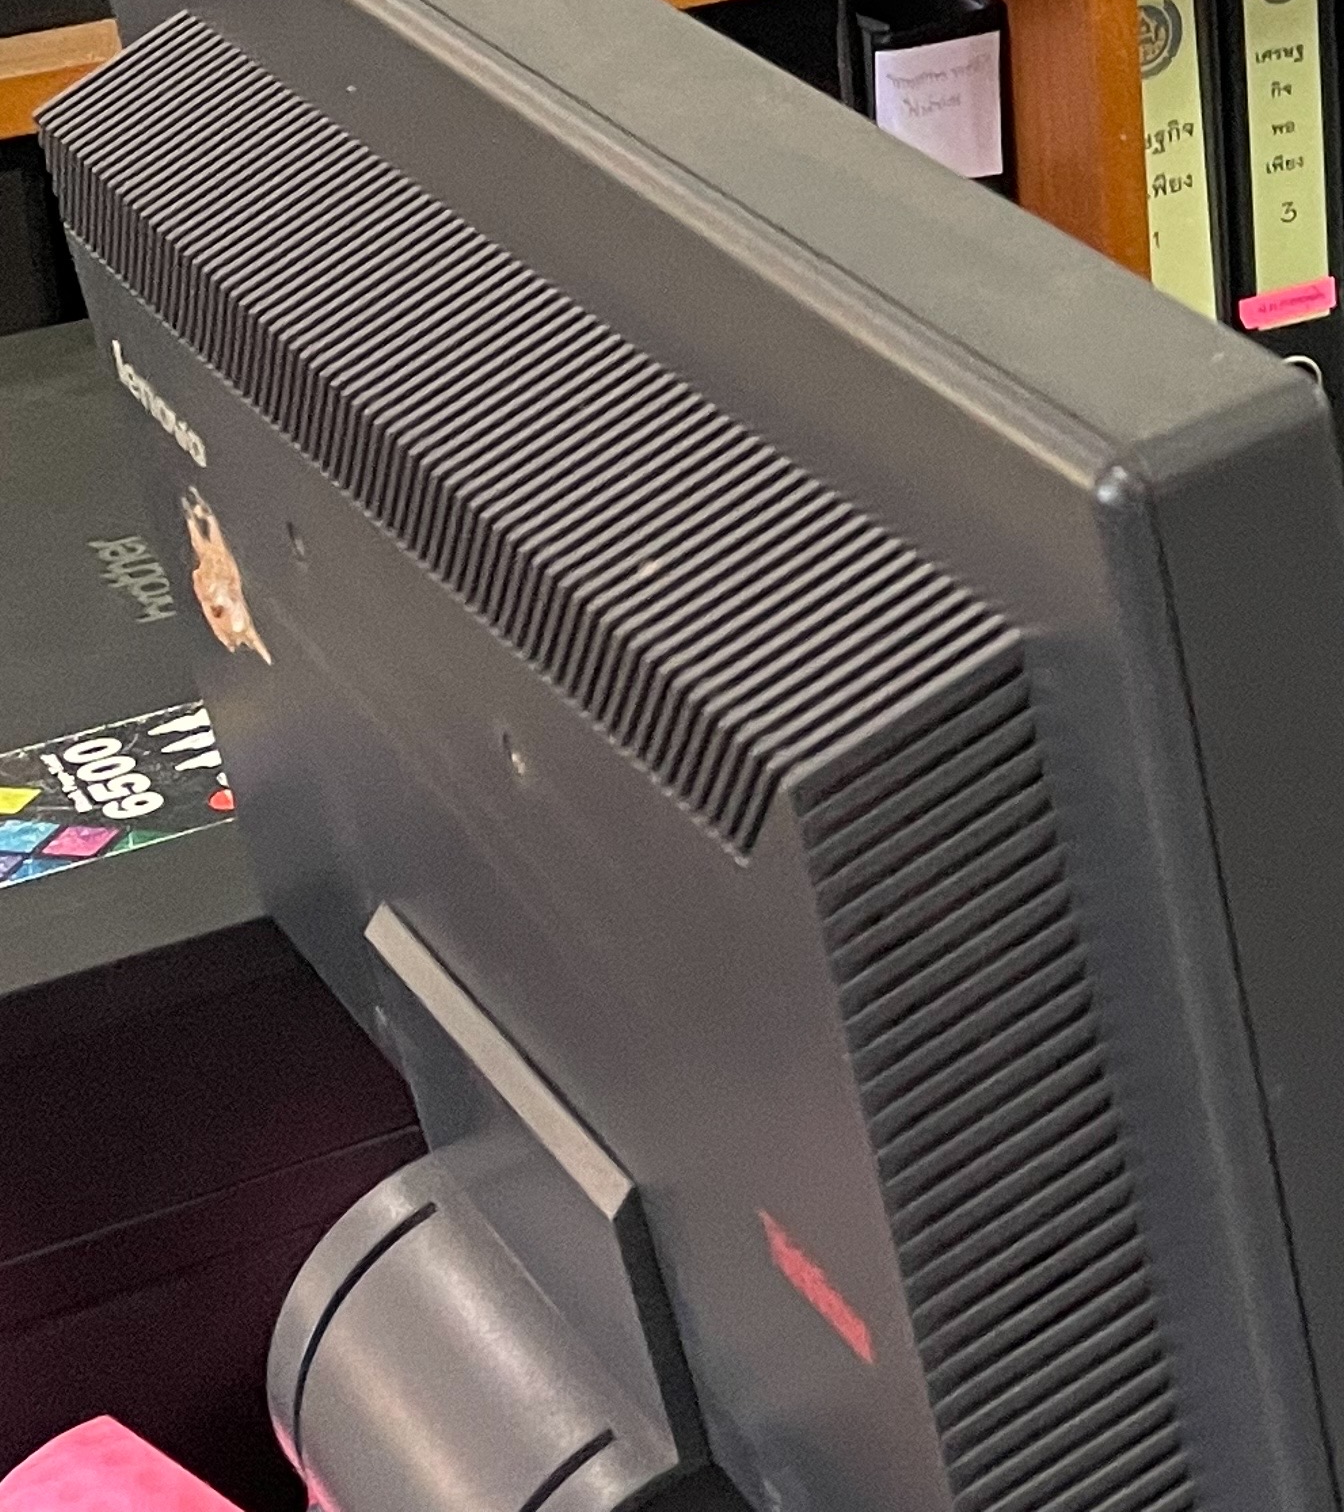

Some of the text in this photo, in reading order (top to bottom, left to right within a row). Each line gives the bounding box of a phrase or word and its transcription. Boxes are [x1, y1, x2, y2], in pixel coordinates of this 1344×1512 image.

[1254, 43, 1305, 64] เศรษฐ
[1270, 80, 1293, 99] กิจ
[1271, 120, 1296, 136] พอ
[1265, 154, 1305, 175] เพียง
[1280, 201, 1298, 223] 3
[112, 339, 207, 468] lenovo
[62, 736, 165, 820] 6500
